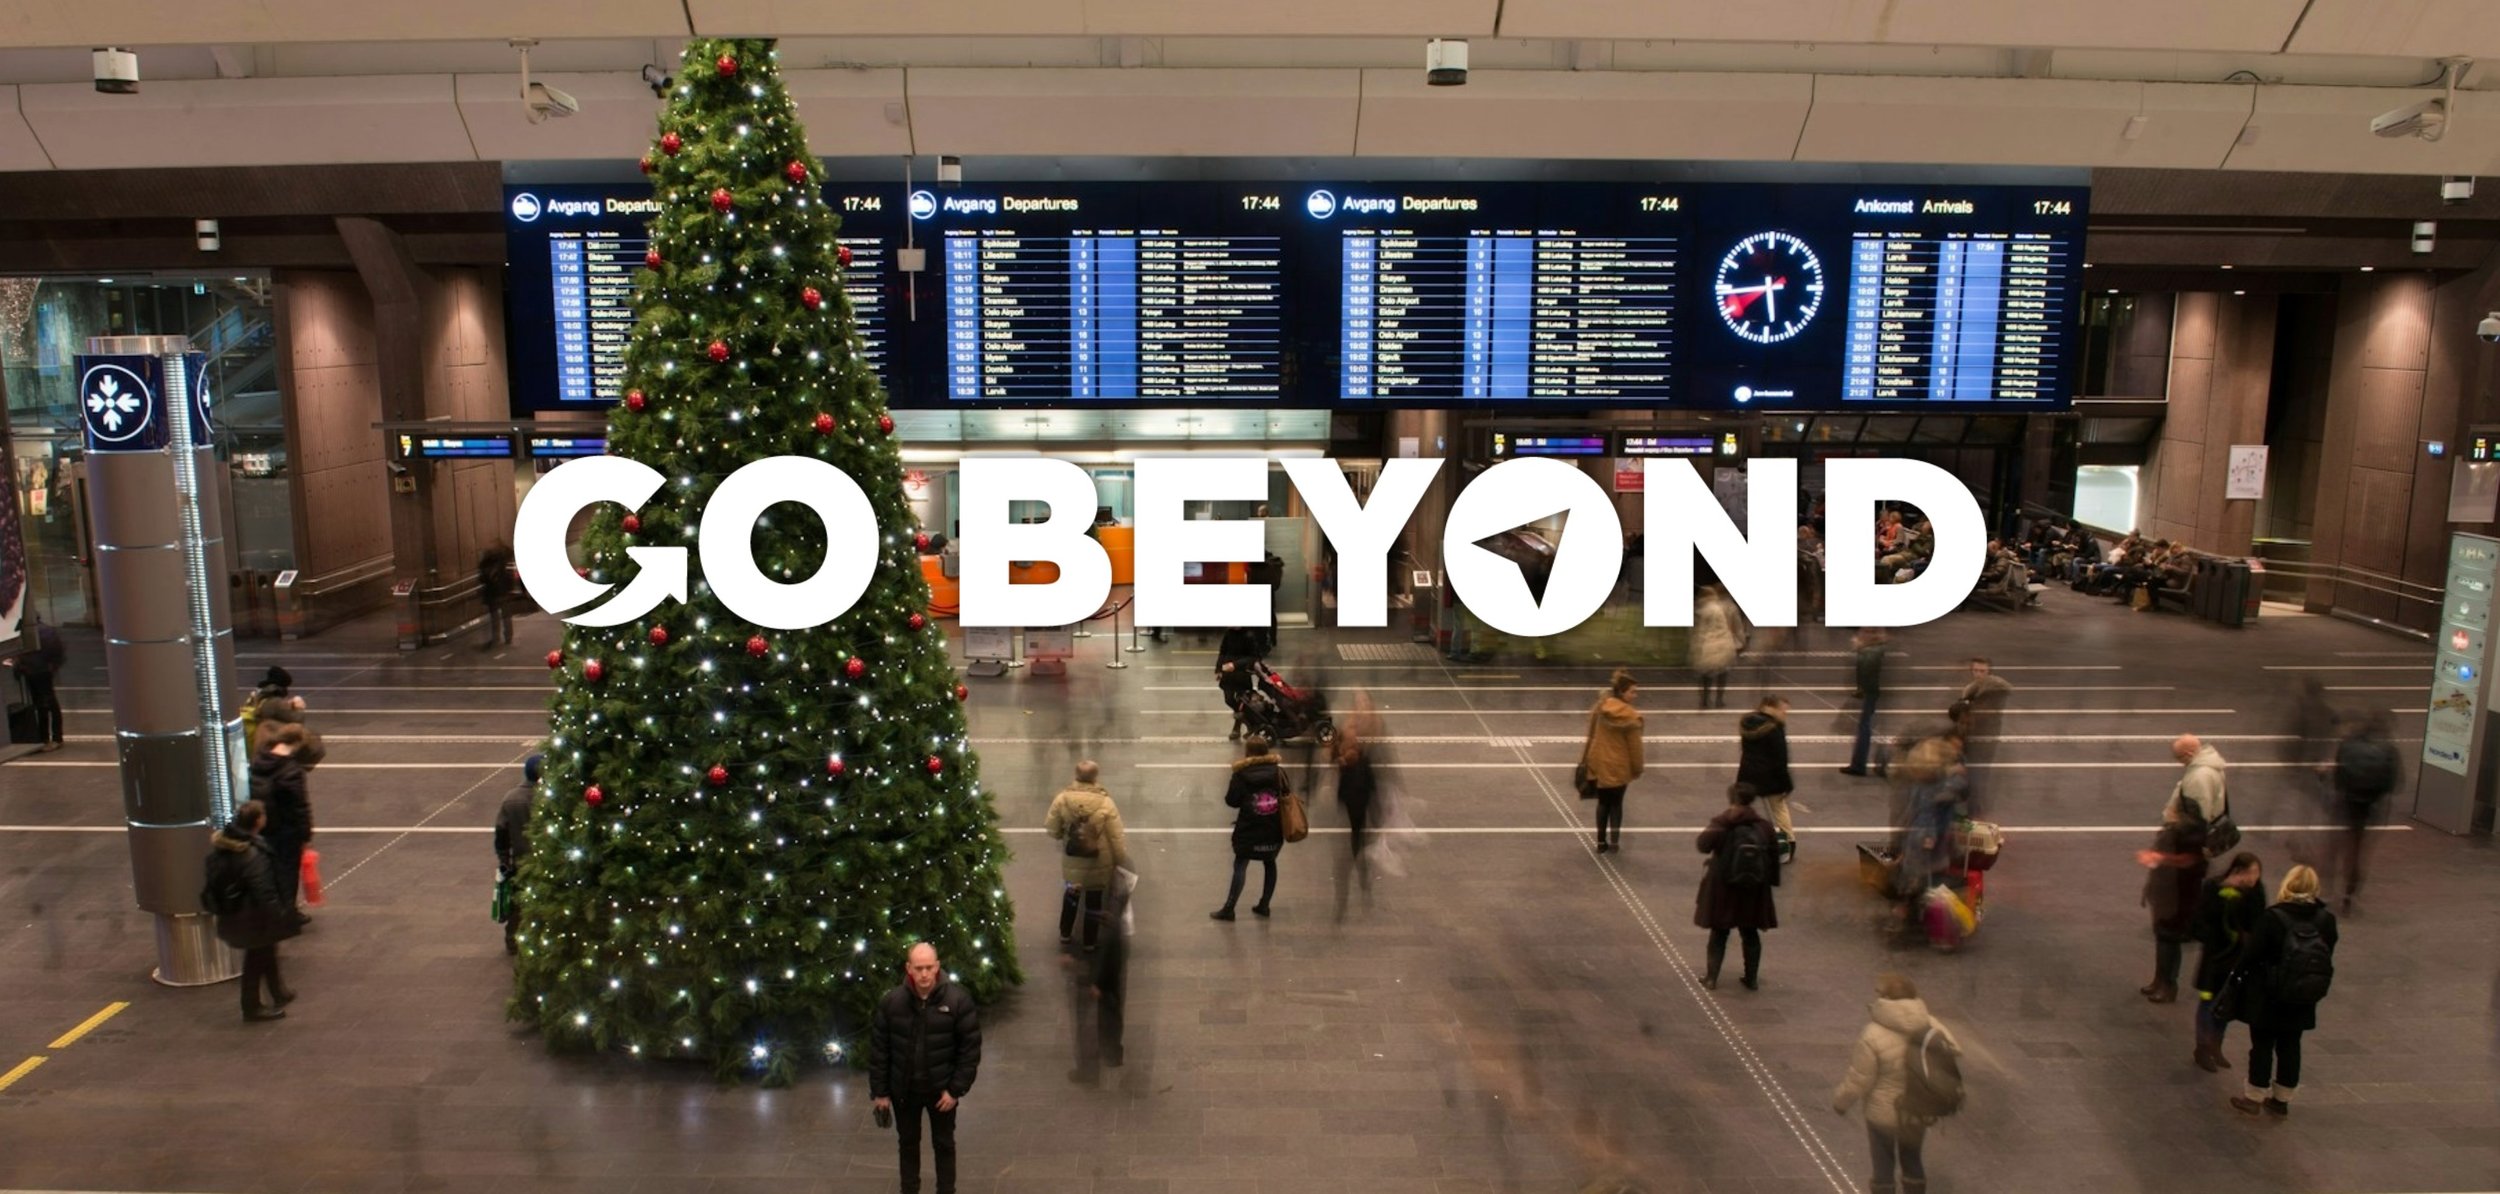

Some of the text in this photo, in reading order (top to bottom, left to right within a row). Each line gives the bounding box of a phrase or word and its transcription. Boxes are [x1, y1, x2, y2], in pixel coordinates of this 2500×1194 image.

[547, 198, 664, 216] Avgang Departur
[843, 196, 882, 211] 17:44
[943, 196, 1079, 213] Avgang Departures
[1241, 195, 1281, 210] 17:44
[1342, 195, 1478, 213] Avgang Departures
[1640, 197, 1679, 212] 17:44
[1854, 198, 1974, 214] Ankomst Arrivals
[2033, 200, 2071, 215] 17:44
[1494, 443, 1505, 455] 9
[1721, 442, 1739, 456] 10
[2473, 447, 2487, 459] 11
